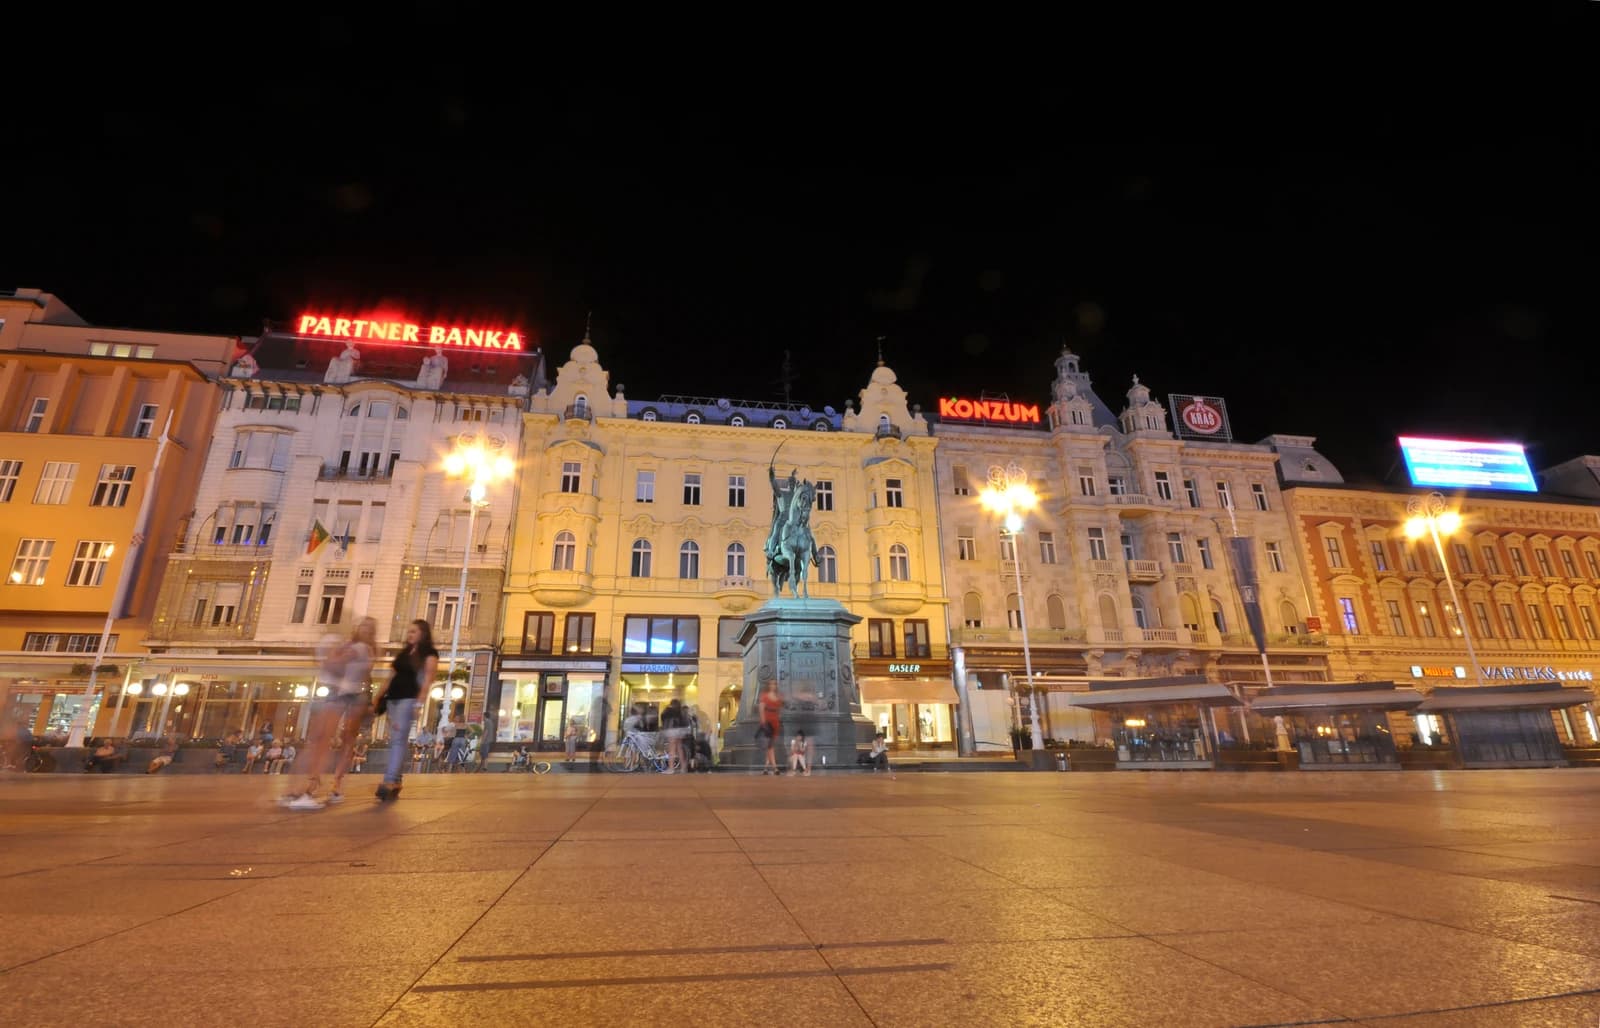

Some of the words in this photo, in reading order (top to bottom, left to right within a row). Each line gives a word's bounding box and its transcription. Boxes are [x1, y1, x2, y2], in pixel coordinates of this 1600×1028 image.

[299, 315, 419, 342] PARTNER
[429, 326, 521, 350] BANKA
[939, 397, 1040, 423] KONZUM
[889, 664, 920, 673] BASLER
[1480, 665, 1557, 680] VARTEKS
